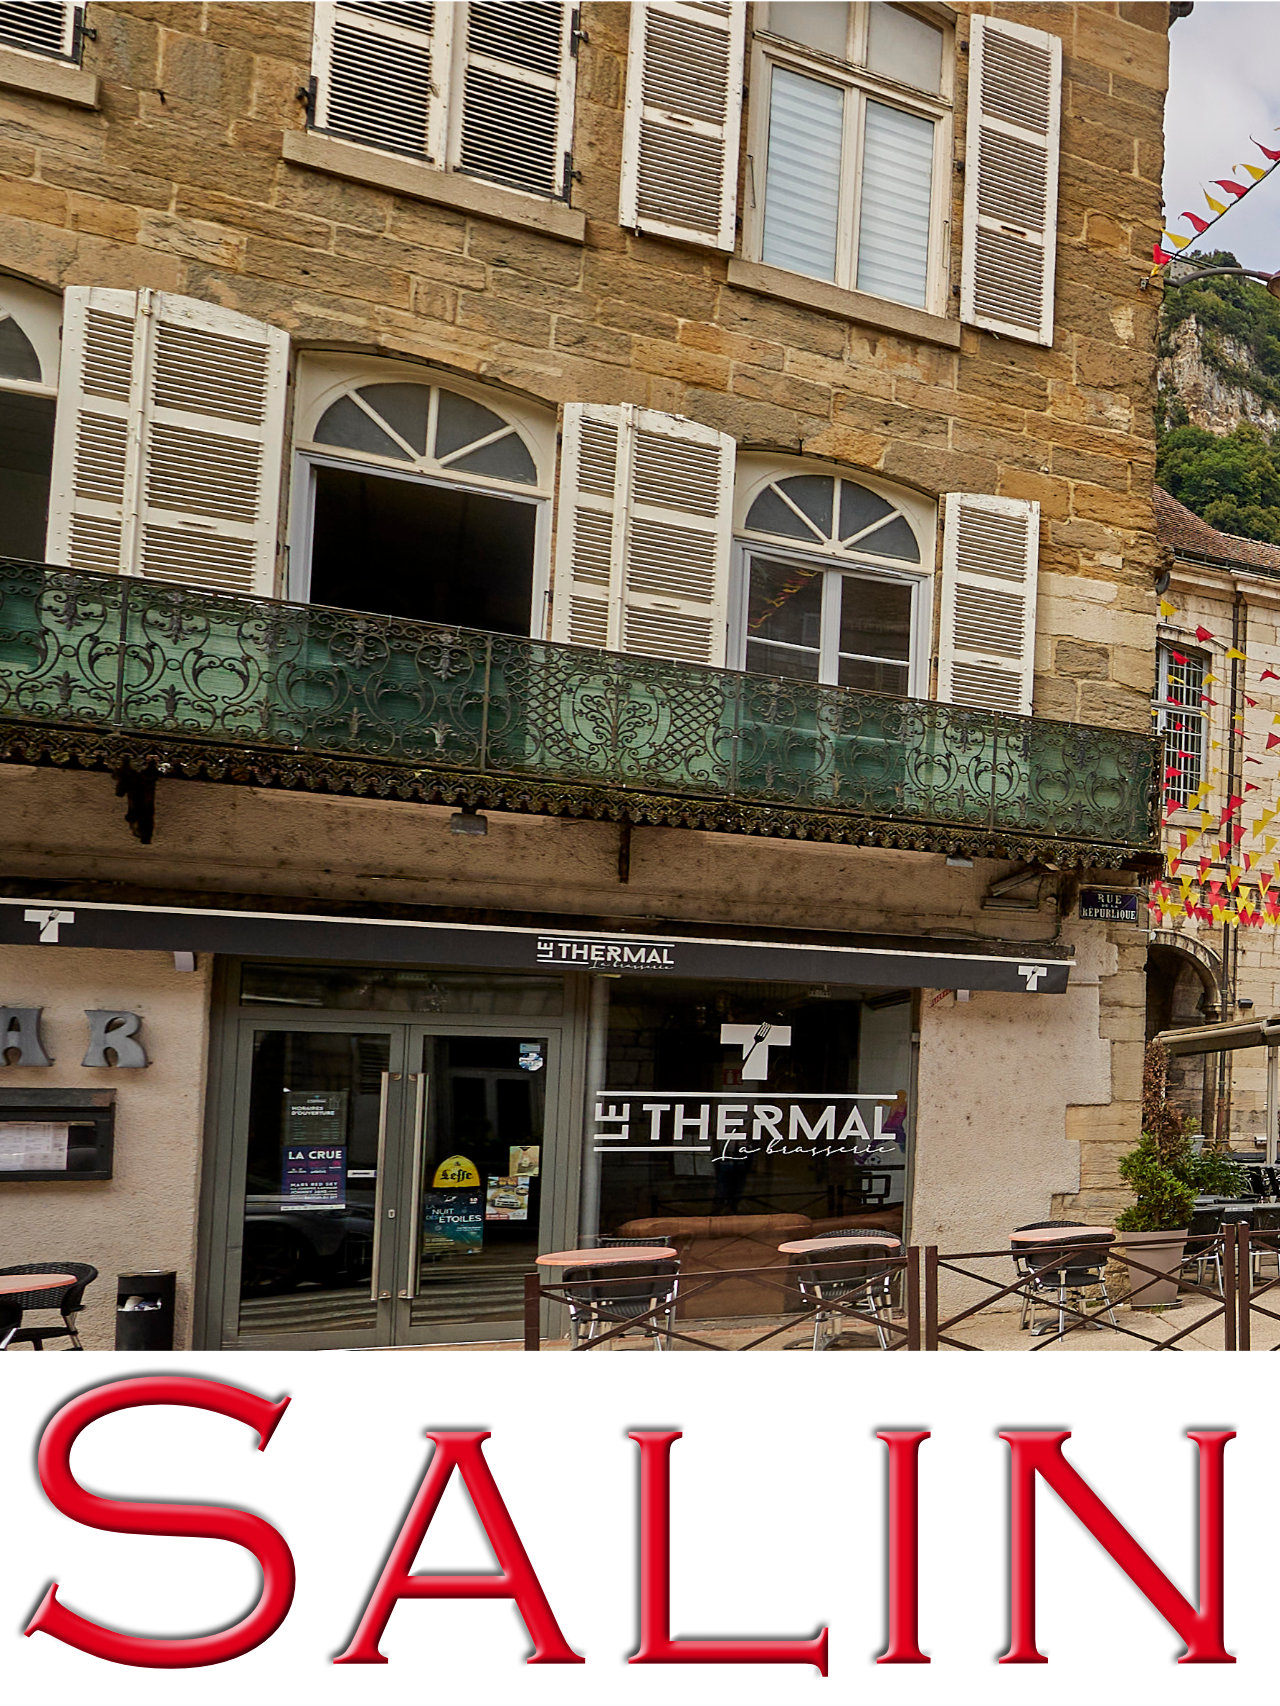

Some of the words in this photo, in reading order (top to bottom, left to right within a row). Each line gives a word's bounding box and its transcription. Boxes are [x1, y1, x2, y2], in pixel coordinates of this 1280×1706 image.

[1097, 893, 1122, 905] RUE
[1082, 905, 1136, 920] RÉPUBLIQUE
[536, 941, 554, 958] LE
[558, 943, 675, 965] THERMAL
[593, 1102, 631, 1140] LE
[642, 1103, 898, 1141] THERMAL
[712, 1128, 761, 1163] La
[765, 1133, 897, 1158] brasserie
[288, 1151, 305, 1160] LA
[308, 1150, 343, 1160] CRUE
[440, 1169, 473, 1183] Leffe
